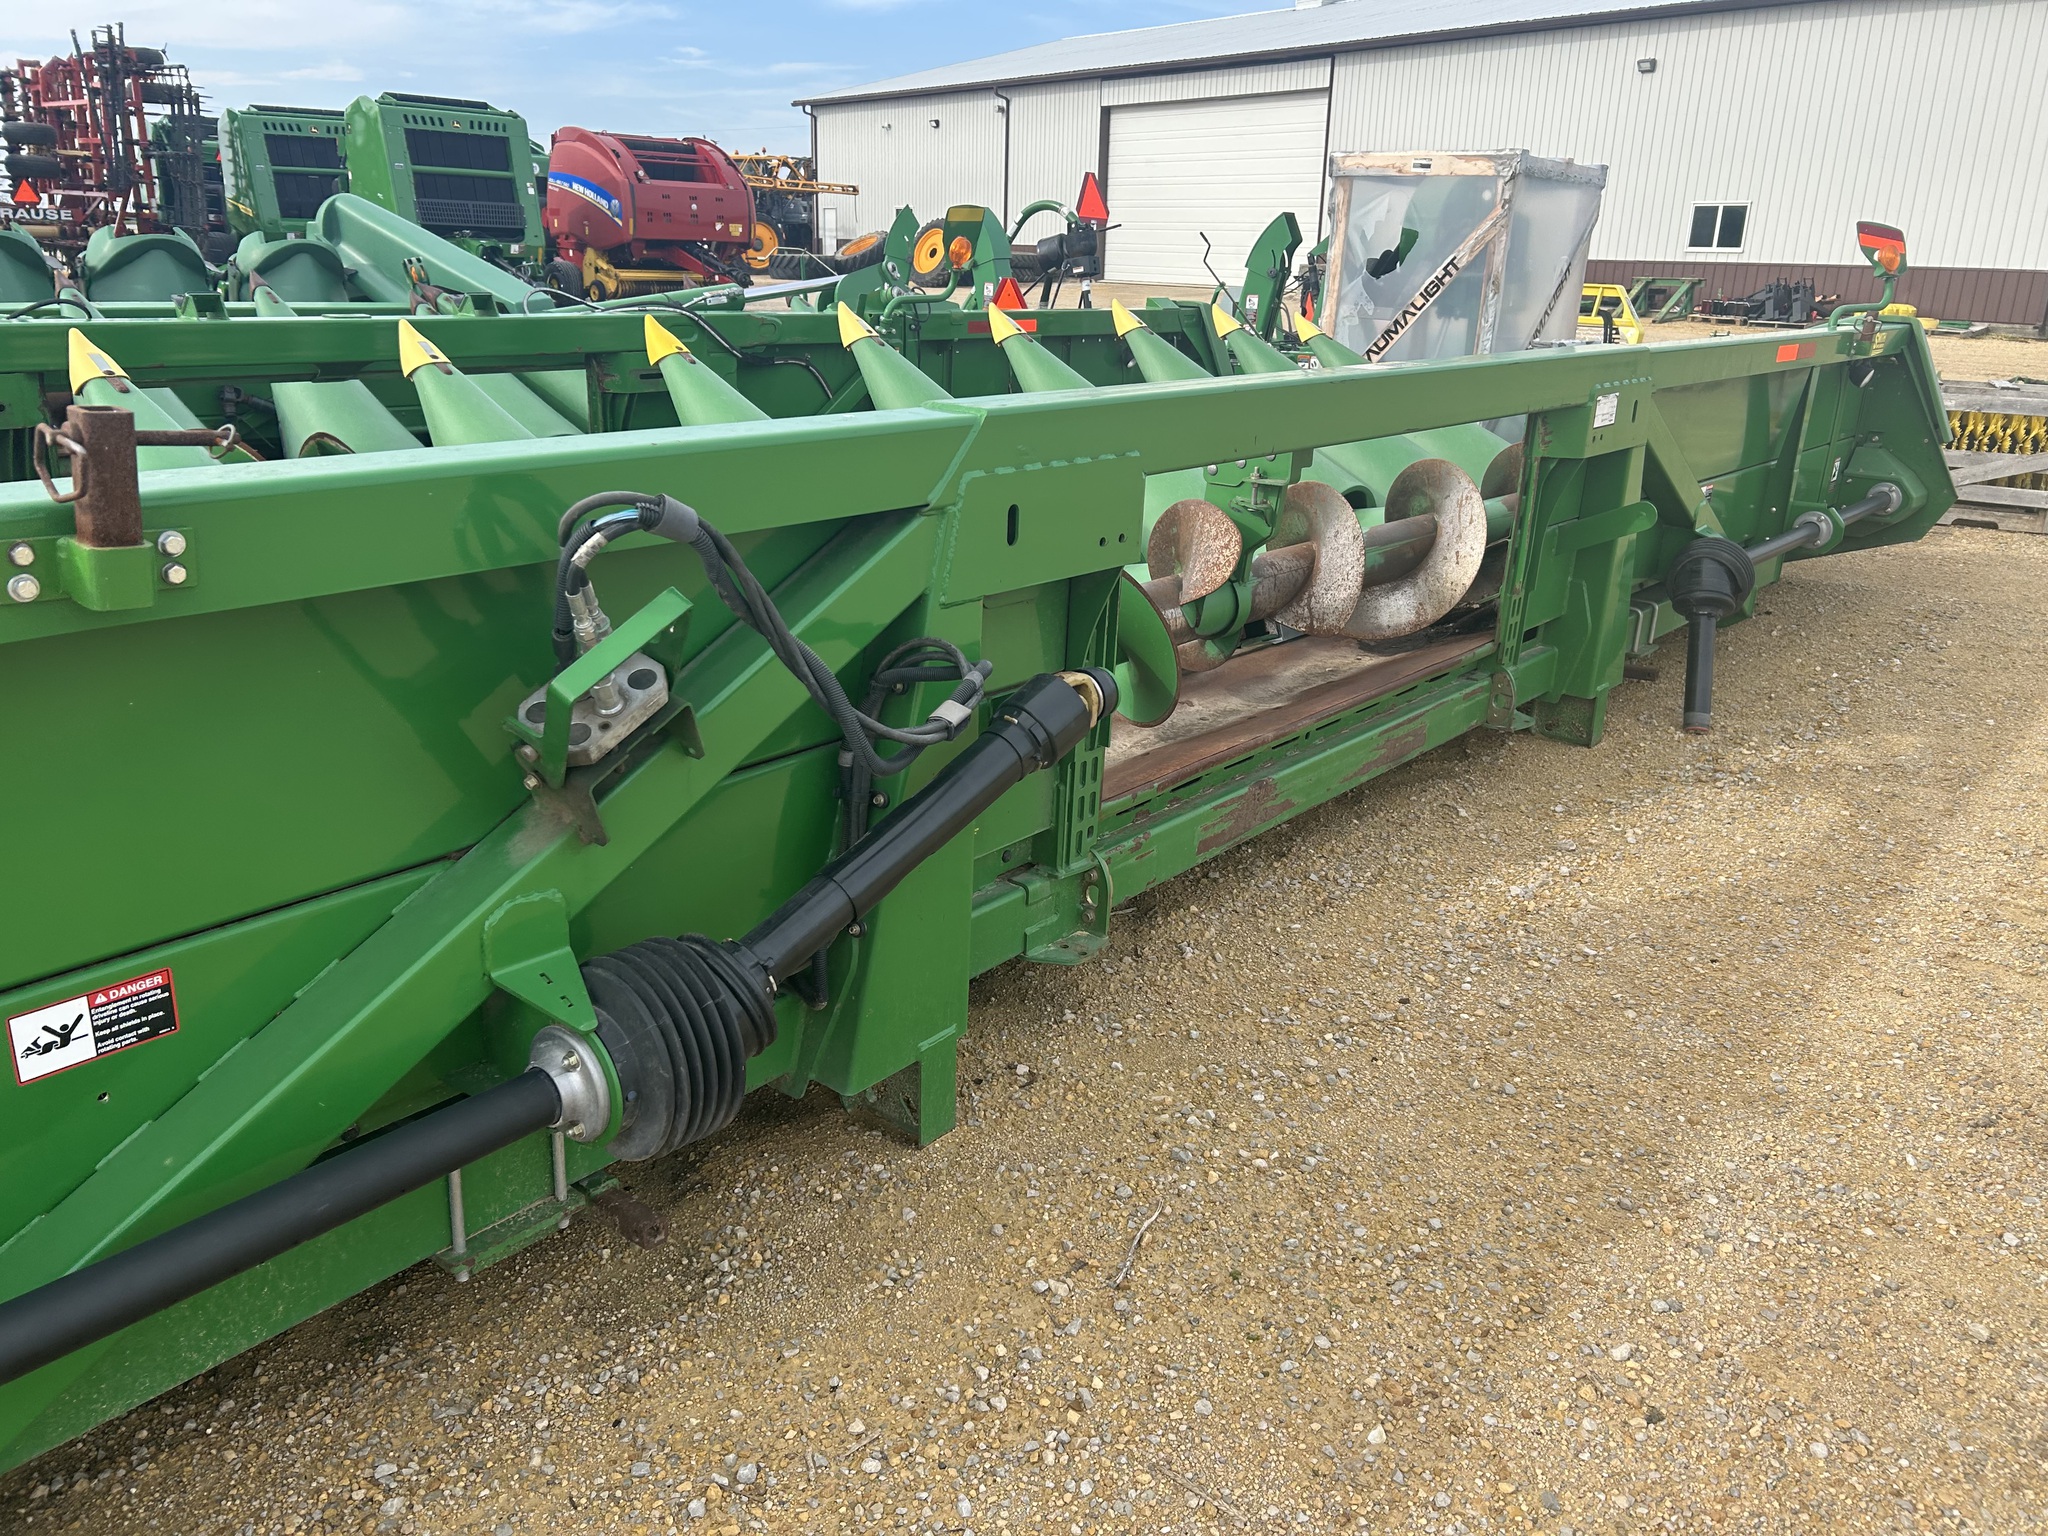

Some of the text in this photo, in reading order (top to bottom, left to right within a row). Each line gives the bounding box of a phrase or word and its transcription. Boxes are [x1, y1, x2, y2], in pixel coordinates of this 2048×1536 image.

[572, 182, 584, 194] NEW
[584, 187, 609, 209] HOLLAND
[0, 208, 72, 220] RAUSE
[1366, 256, 1460, 362] AUMALIGHT
[109, 976, 162, 1000] DANGER
[91, 997, 131, 1014] Entanglement
[139, 988, 161, 998] rotating
[92, 1008, 117, 1020] driveline
[130, 1000, 147, 1008] cause
[148, 992, 169, 1002] serious
[93, 1016, 110, 1026] injury
[119, 1009, 137, 1018] death.
[95, 1028, 110, 1037] Keep
[120, 1019, 140, 1029] shields
[148, 1011, 165, 1020] place.
[97, 1038, 114, 1048] Avoid
[115, 1031, 136, 1042] contact
[98, 1037, 138, 1054] rotating parts.
